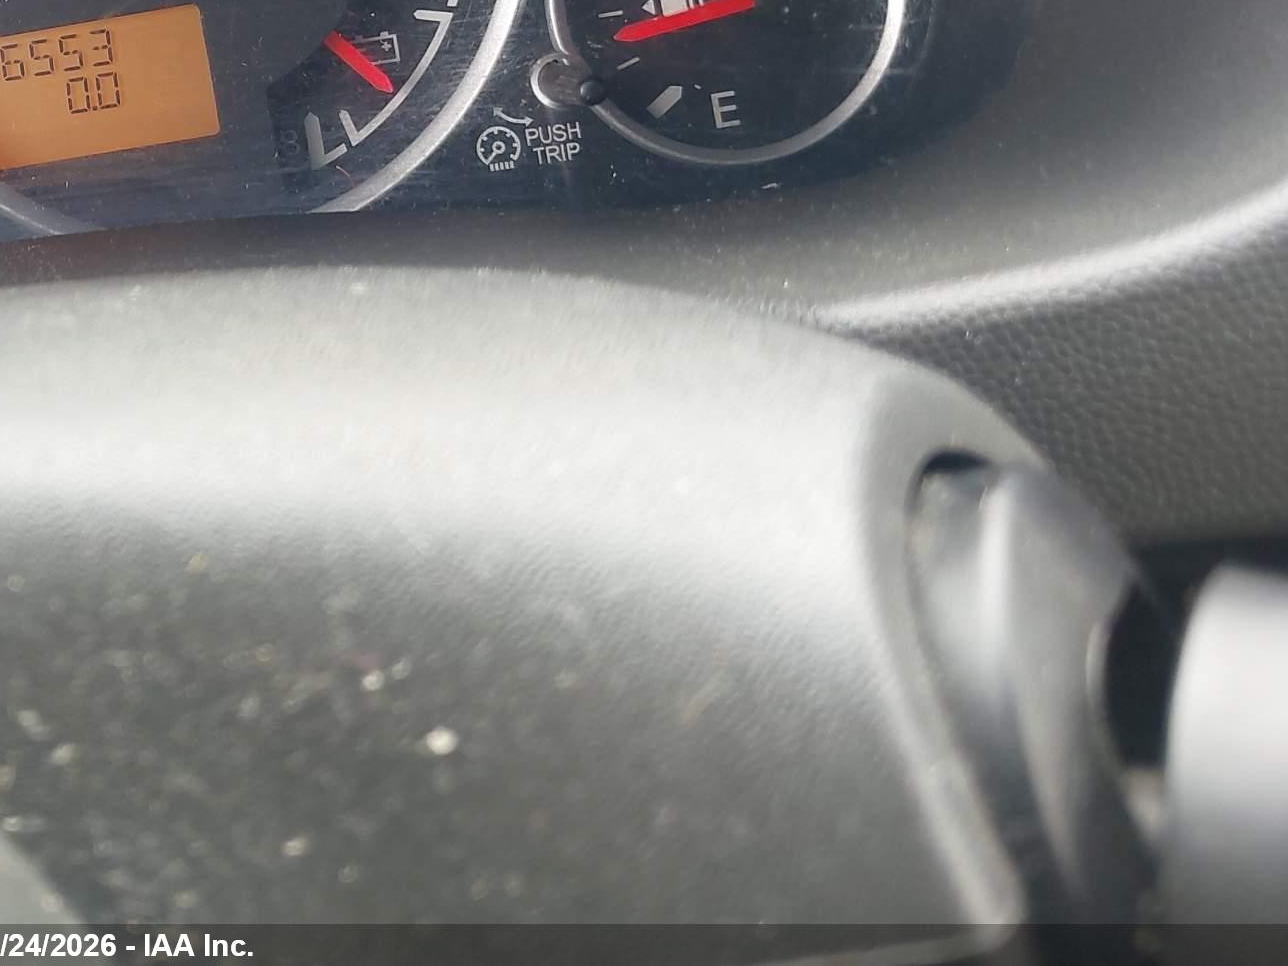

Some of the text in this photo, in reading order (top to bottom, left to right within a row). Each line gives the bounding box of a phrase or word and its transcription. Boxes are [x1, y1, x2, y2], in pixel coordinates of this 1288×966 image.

[66, 71, 122, 115] 0.0
[710, 90, 742, 130] E
[524, 121, 583, 148] PUSH
[532, 141, 582, 167] TRIP
